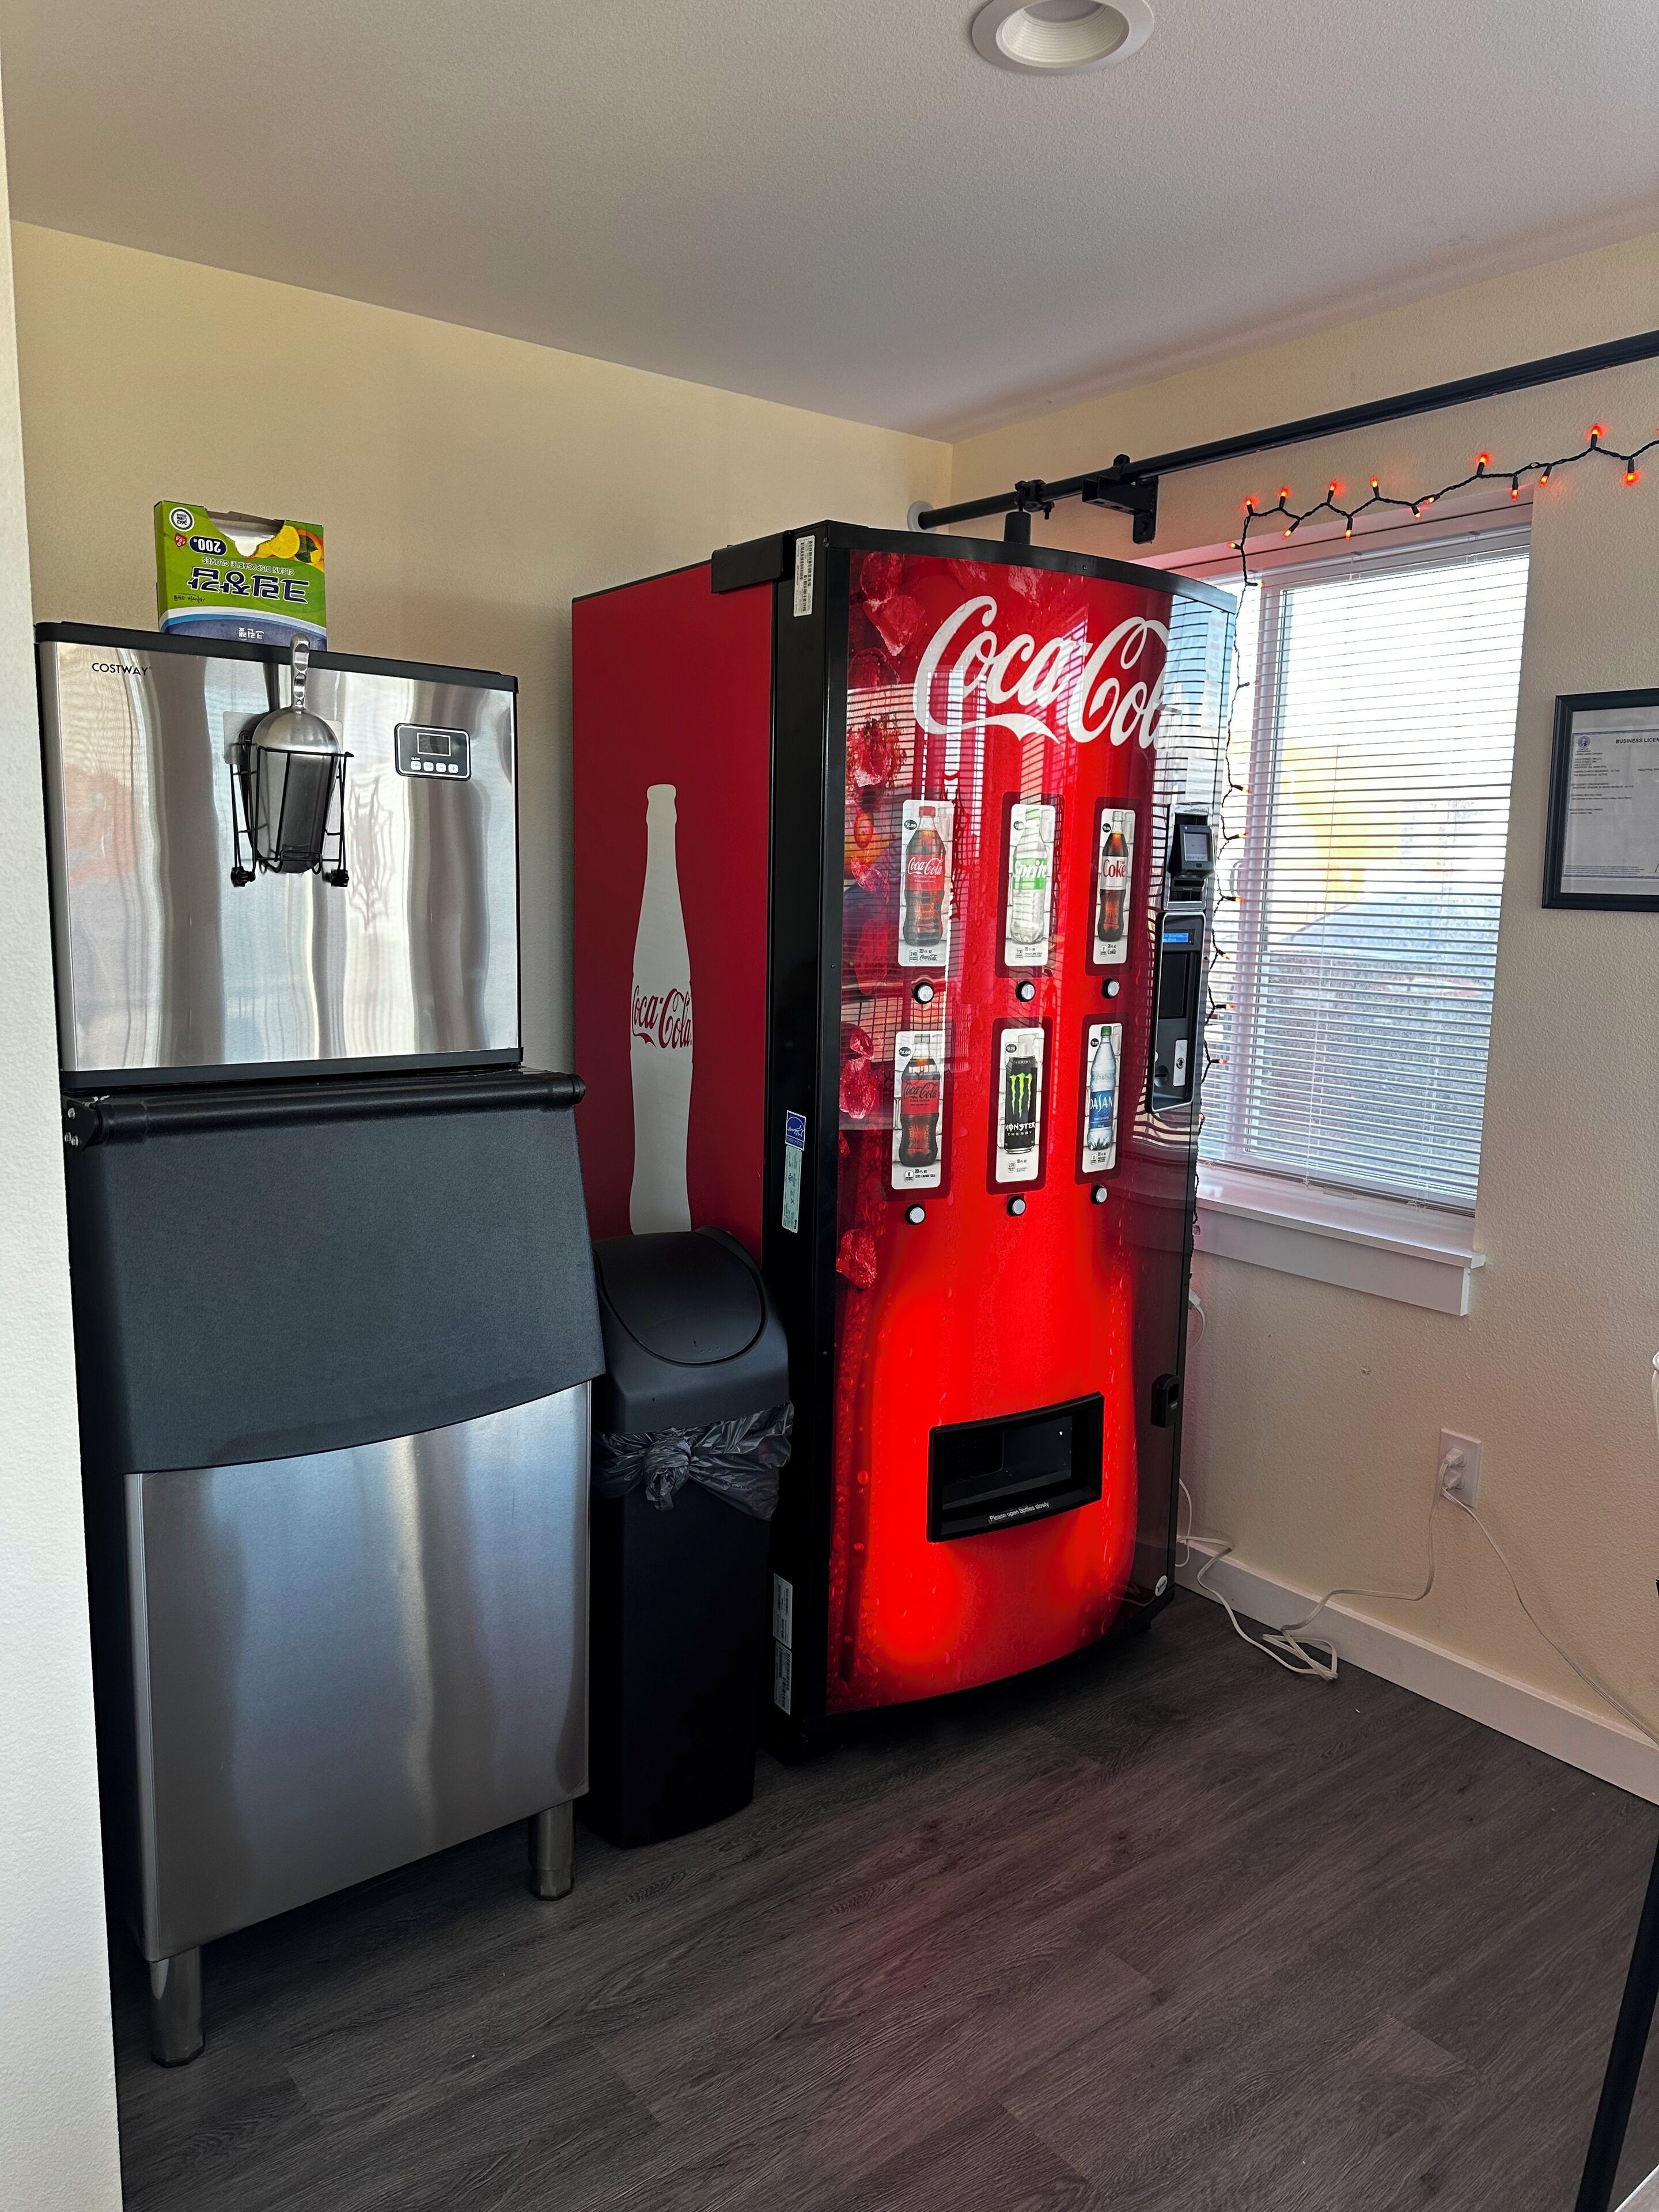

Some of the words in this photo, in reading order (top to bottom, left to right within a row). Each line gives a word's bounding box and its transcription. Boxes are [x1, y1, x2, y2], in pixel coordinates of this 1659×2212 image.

[202, 557, 229, 567] GLOVES
[231, 561, 271, 573] DISPOSABLE
[273, 566, 294, 576] CLEAN
[187, 567, 310, 604] 크린장갑
[92, 662, 148, 676] COSTWAY
[912, 595, 1169, 751] Coca-Col
[908, 857, 944, 876] Coca-Cola
[1013, 859, 1047, 882] Sprite
[1103, 858, 1126, 878] Coke
[632, 985, 692, 1049] Coca-Cola
[904, 1082, 938, 1099] Coca-Cola
[989, 1513, 1006, 1521] Please
[1007, 1509, 1019, 1518] open
[1020, 1505, 1035, 1514] bottles
[1035, 1501, 1050, 1510] slowly
